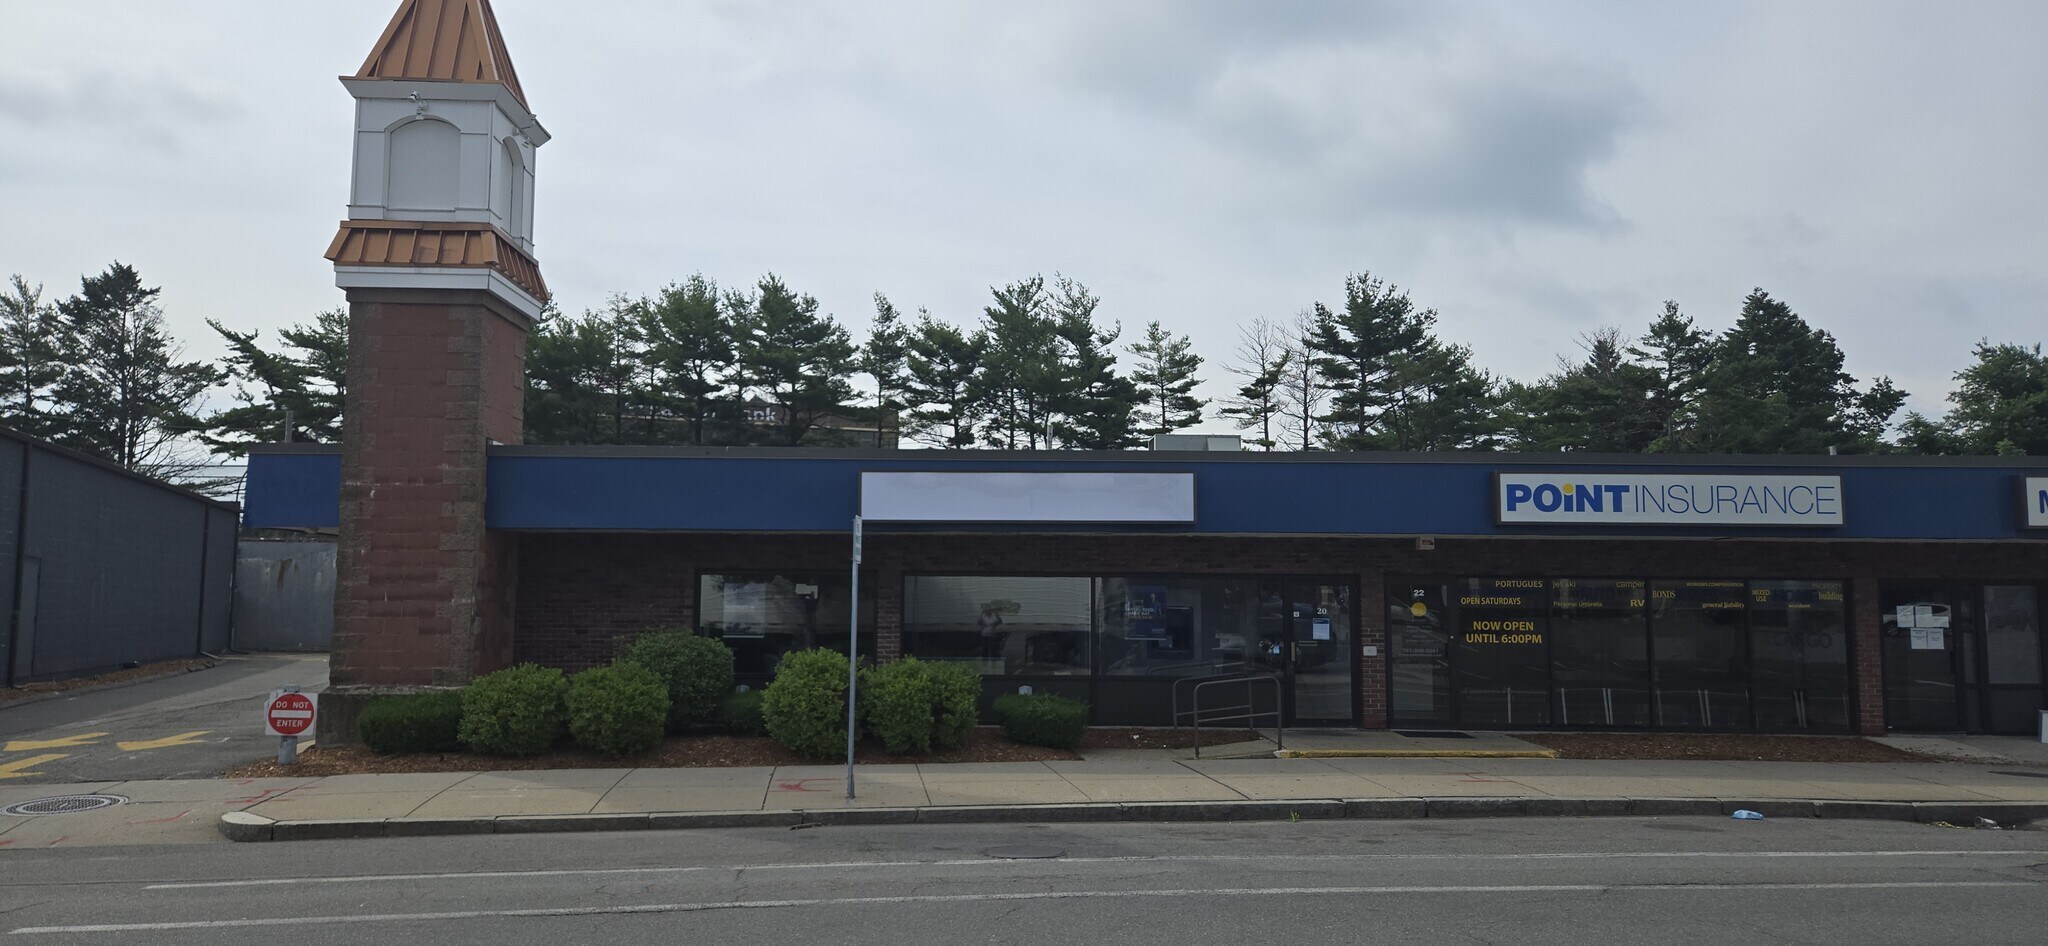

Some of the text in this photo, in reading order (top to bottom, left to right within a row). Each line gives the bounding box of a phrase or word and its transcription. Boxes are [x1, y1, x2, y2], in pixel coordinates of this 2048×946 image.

[1634, 484, 1838, 515] INSURANCE
[1616, 581, 1645, 589] camper
[1413, 589, 1425, 597] 22
[1652, 590, 1676, 598] BONDS
[1818, 591, 1844, 602] building
[1461, 597, 1521, 605] OPEN SATURDAYS
[1630, 599, 1645, 607] RV
[1473, 621, 1534, 631] NOW OPEN
[1466, 633, 1542, 644] UNTIL 6:00PM
[292, 701, 309, 709] NOT
